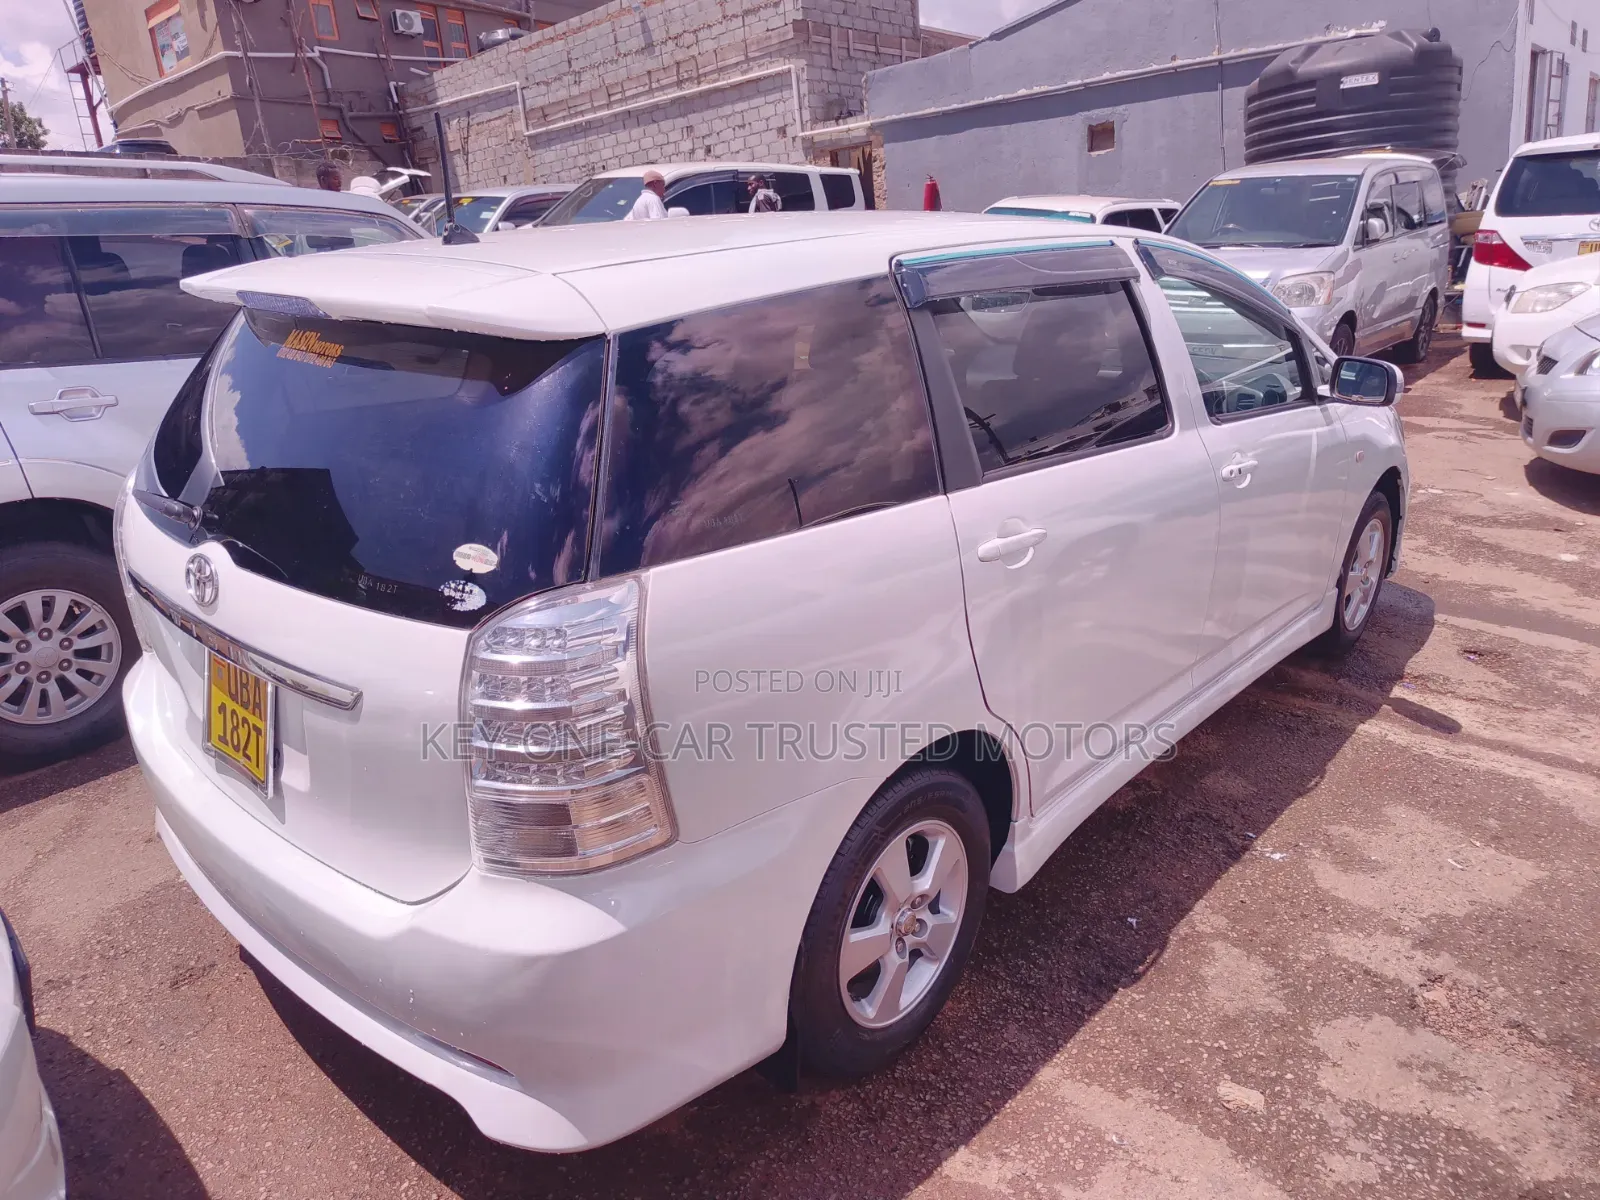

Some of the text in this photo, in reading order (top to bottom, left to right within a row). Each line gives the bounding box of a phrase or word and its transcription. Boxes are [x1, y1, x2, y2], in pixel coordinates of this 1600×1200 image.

[376, 582, 399, 594] 182T
[228, 662, 262, 721] UBA
[218, 702, 262, 768] 182T
